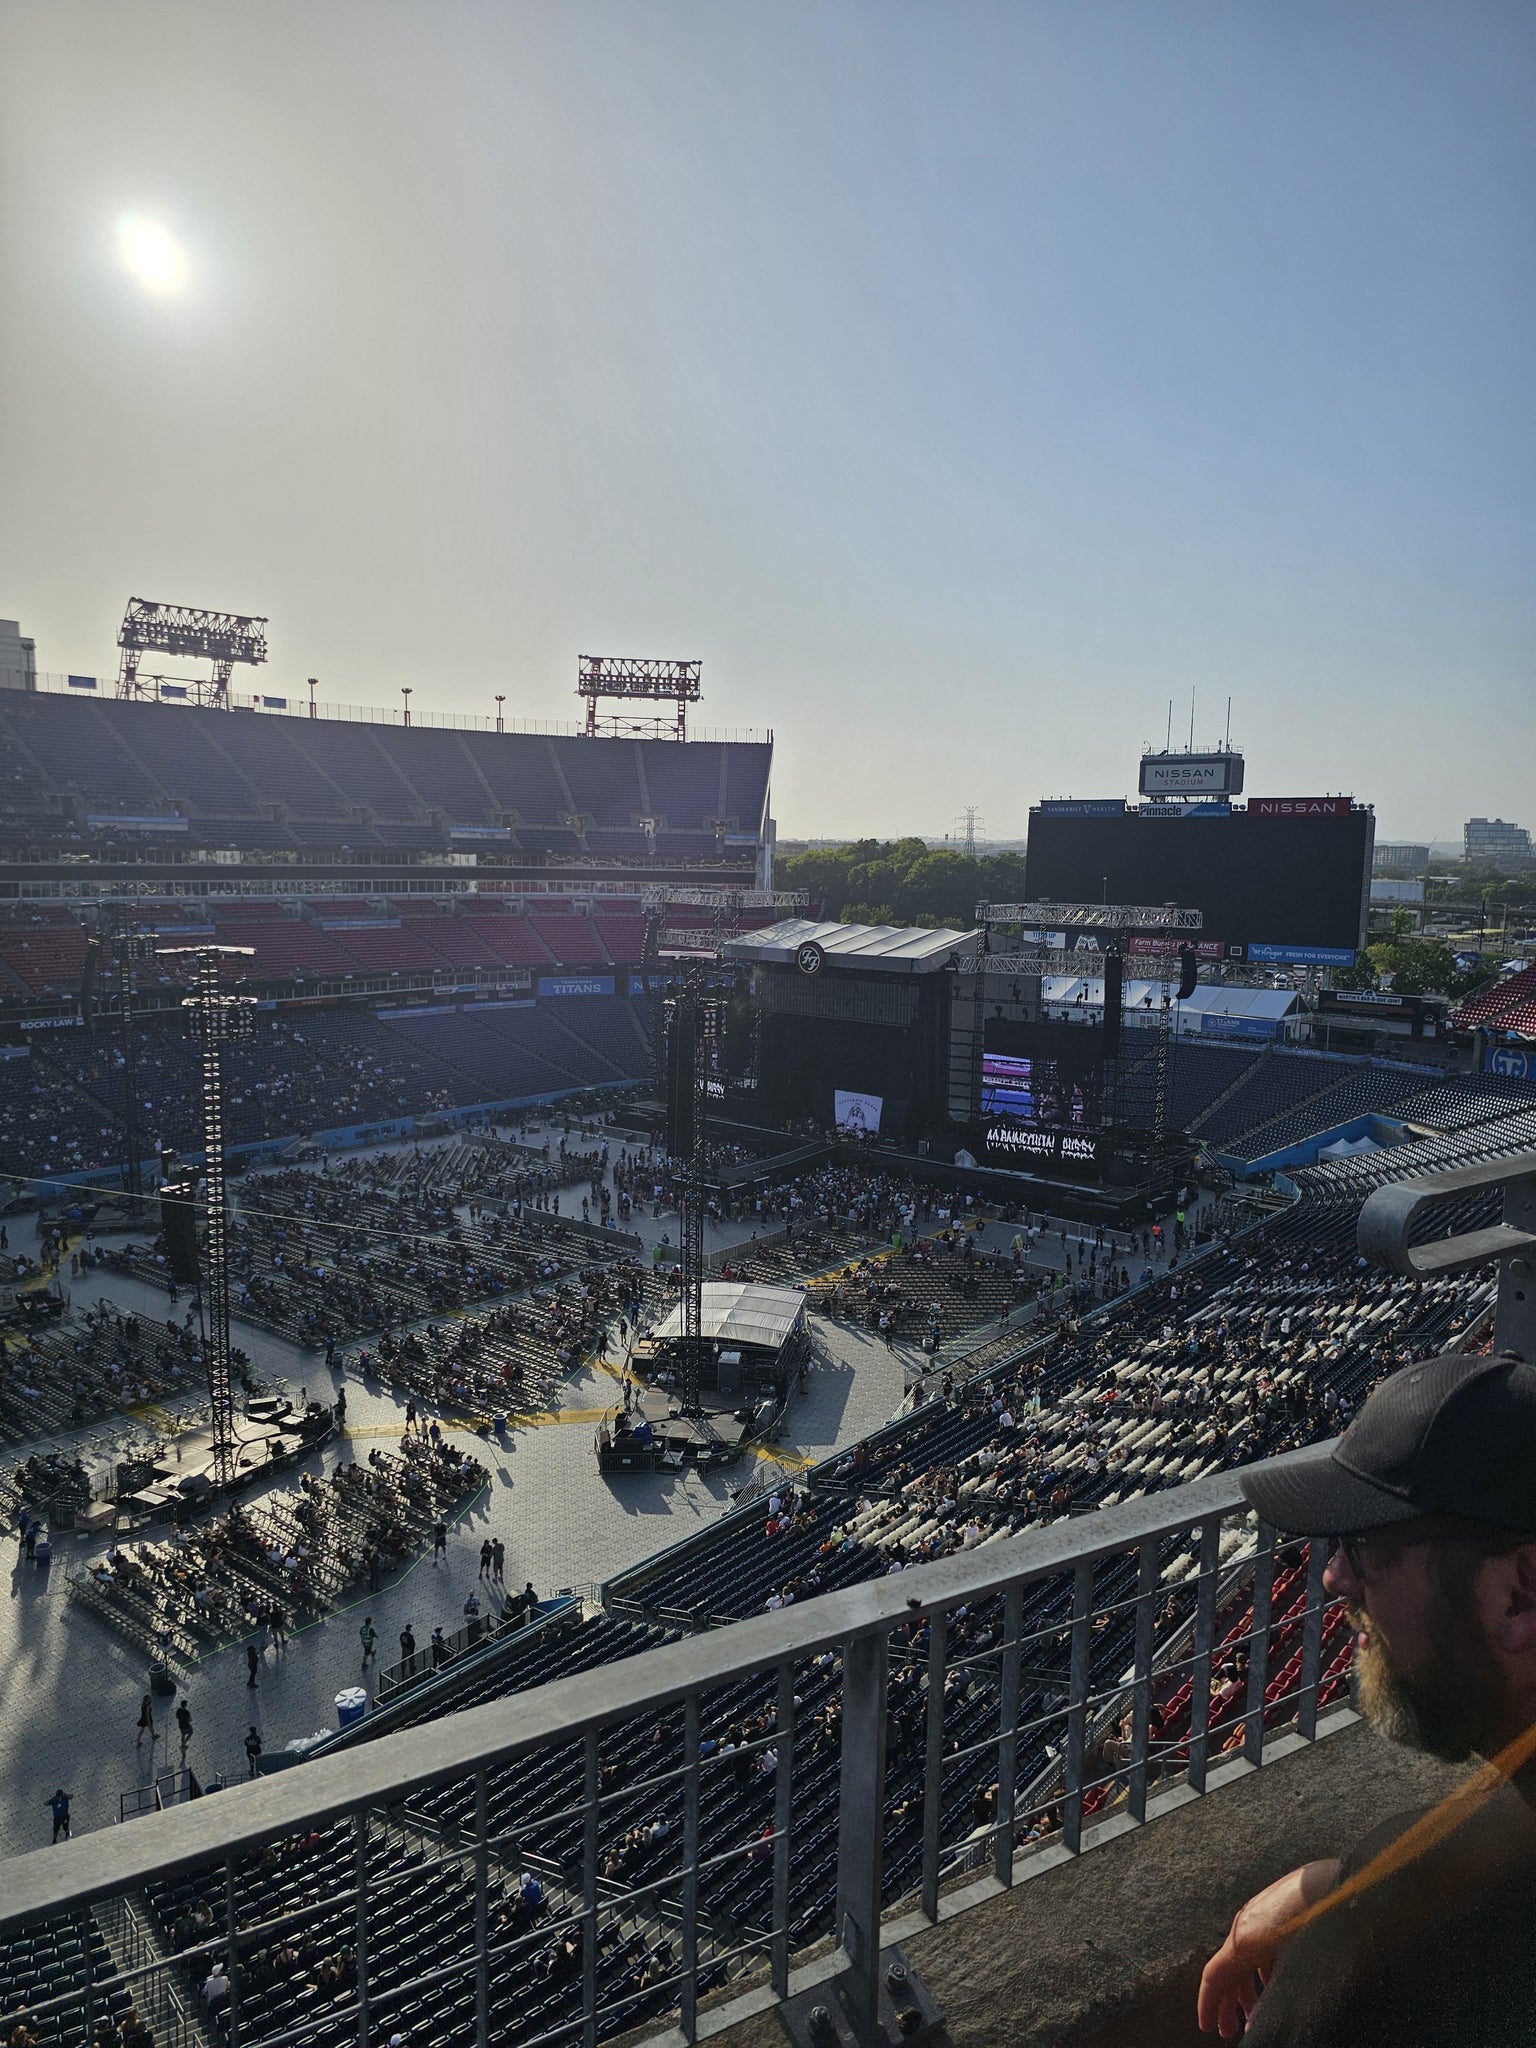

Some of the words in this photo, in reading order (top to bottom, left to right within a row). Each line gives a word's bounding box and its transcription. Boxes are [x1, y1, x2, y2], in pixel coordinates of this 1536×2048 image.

[1155, 769, 1214, 778] NISSAN
[1140, 805, 1182, 816] Pinnacle
[1260, 803, 1336, 813] NISSAN
[553, 984, 602, 993] TITANS
[20, 1020, 52, 1030] ROCKY
[54, 1018, 73, 1027] LAW
